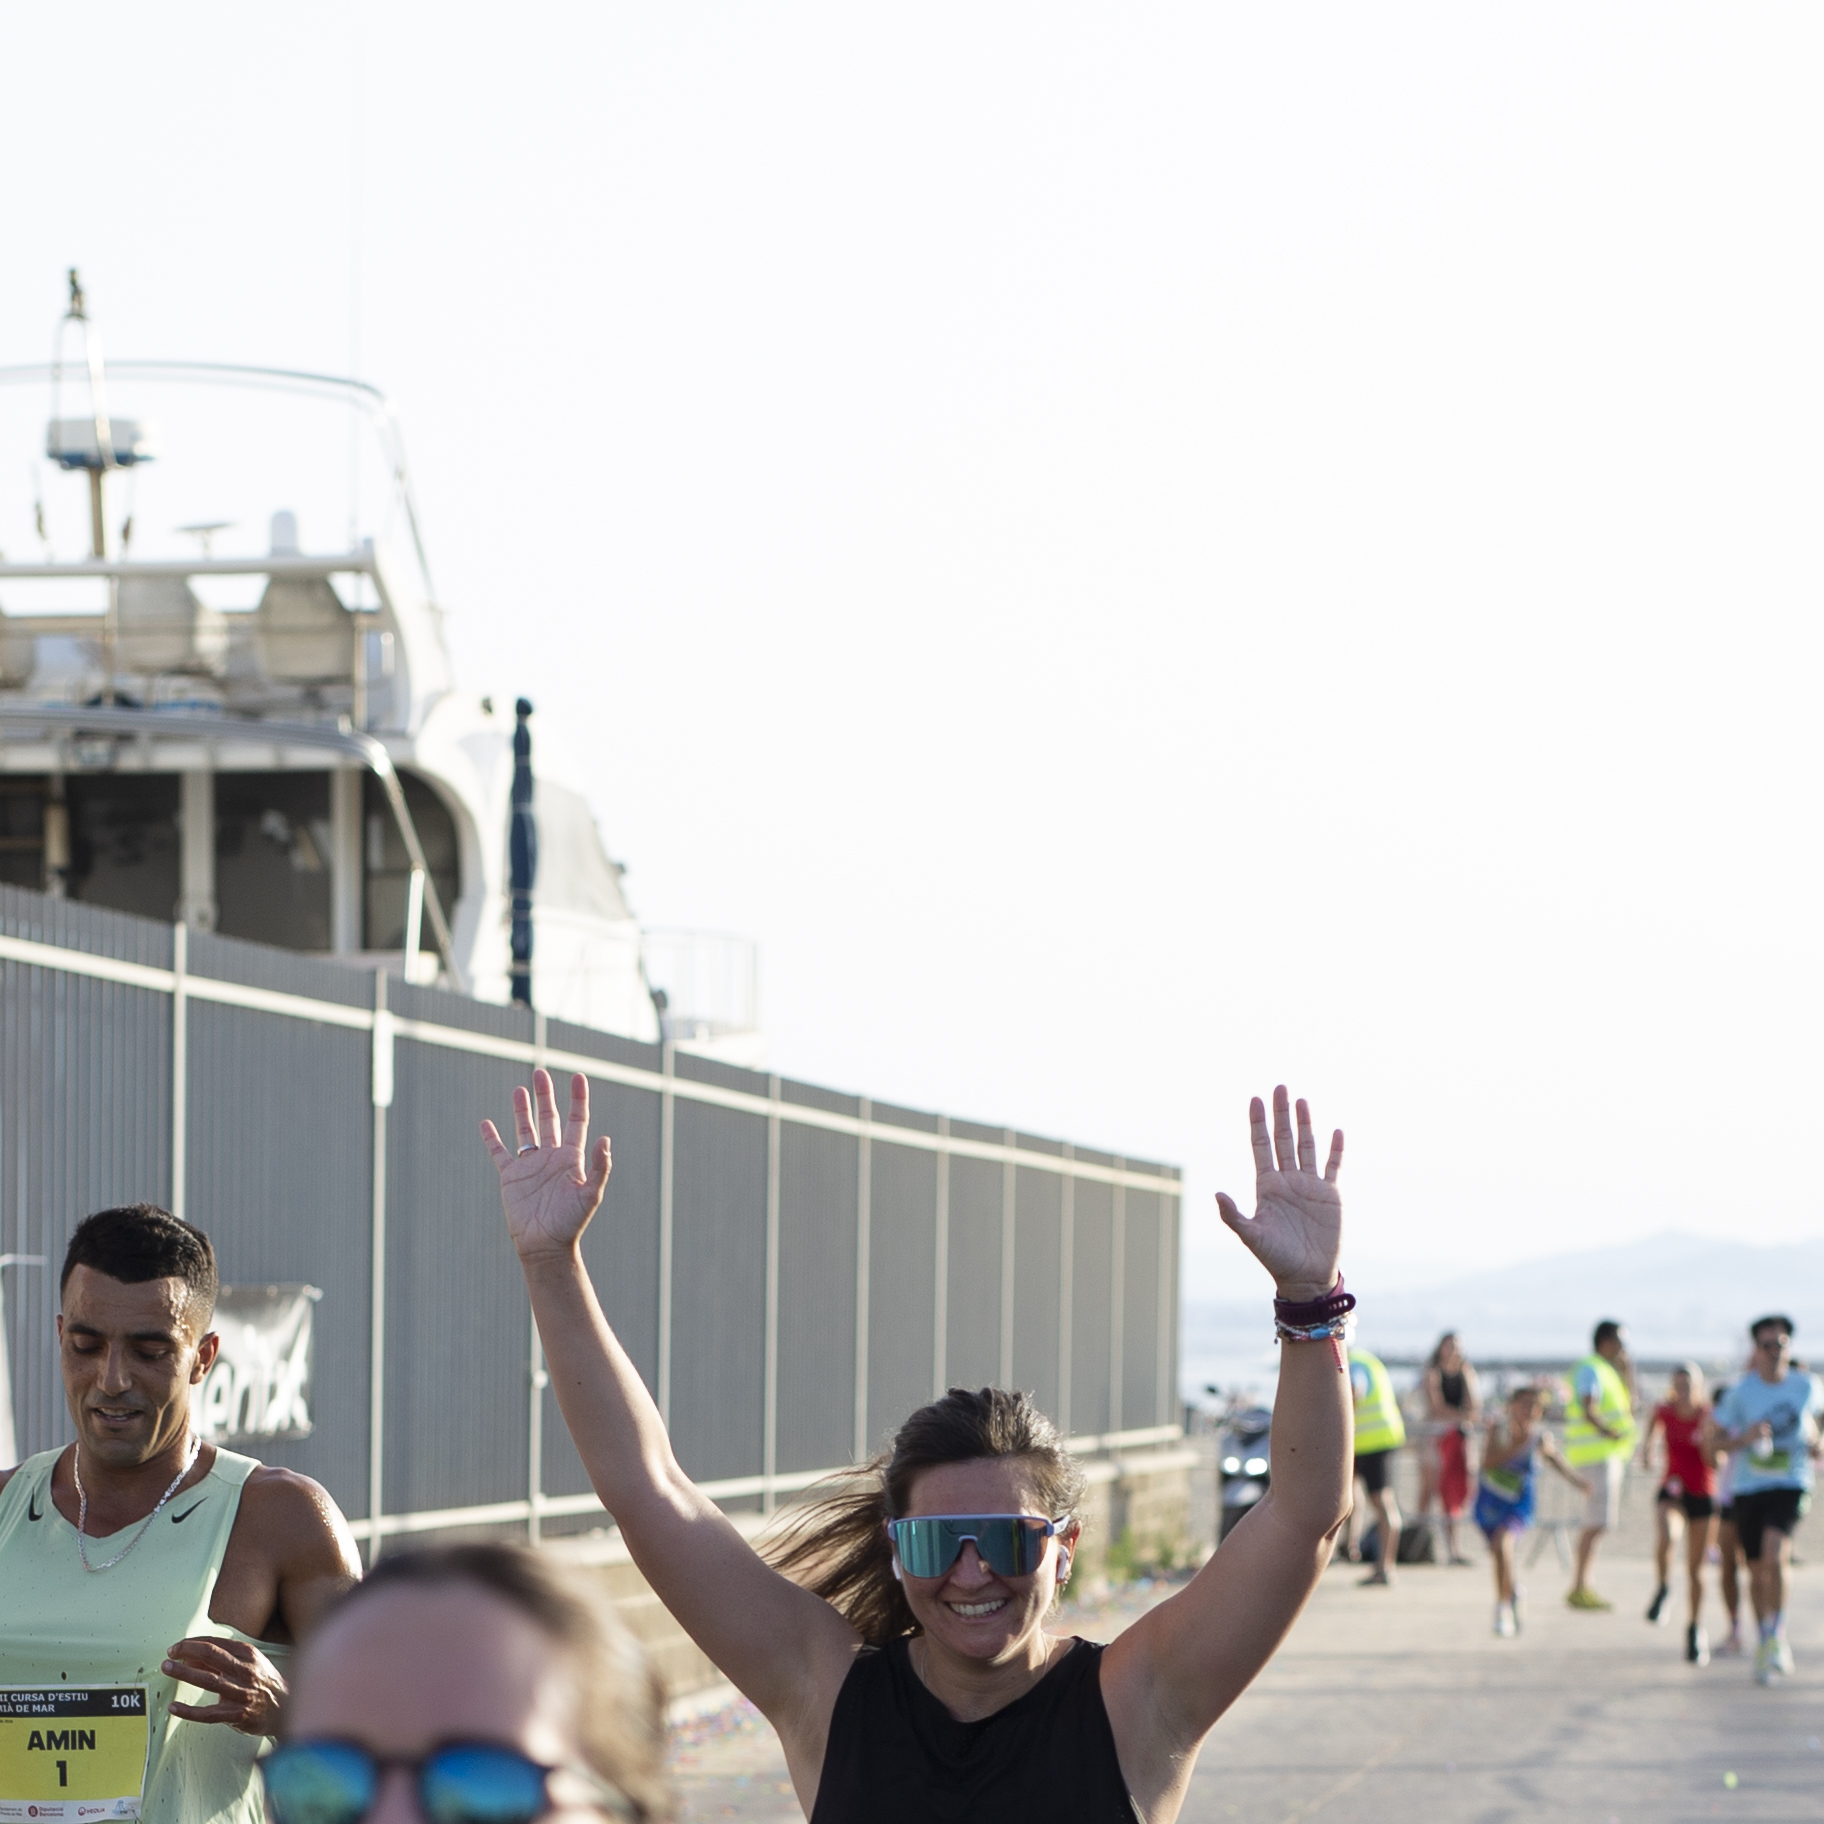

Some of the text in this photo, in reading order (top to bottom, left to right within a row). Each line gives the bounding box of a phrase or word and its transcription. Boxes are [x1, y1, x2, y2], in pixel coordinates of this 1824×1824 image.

[10, 1693, 45, 1702] CURSA
[111, 1695, 141, 1708] 10K
[17, 1704, 30, 1712] DE
[32, 1704, 56, 1713] MAR
[27, 1729, 96, 1751] AMIN
[56, 1760, 68, 1787] 1
